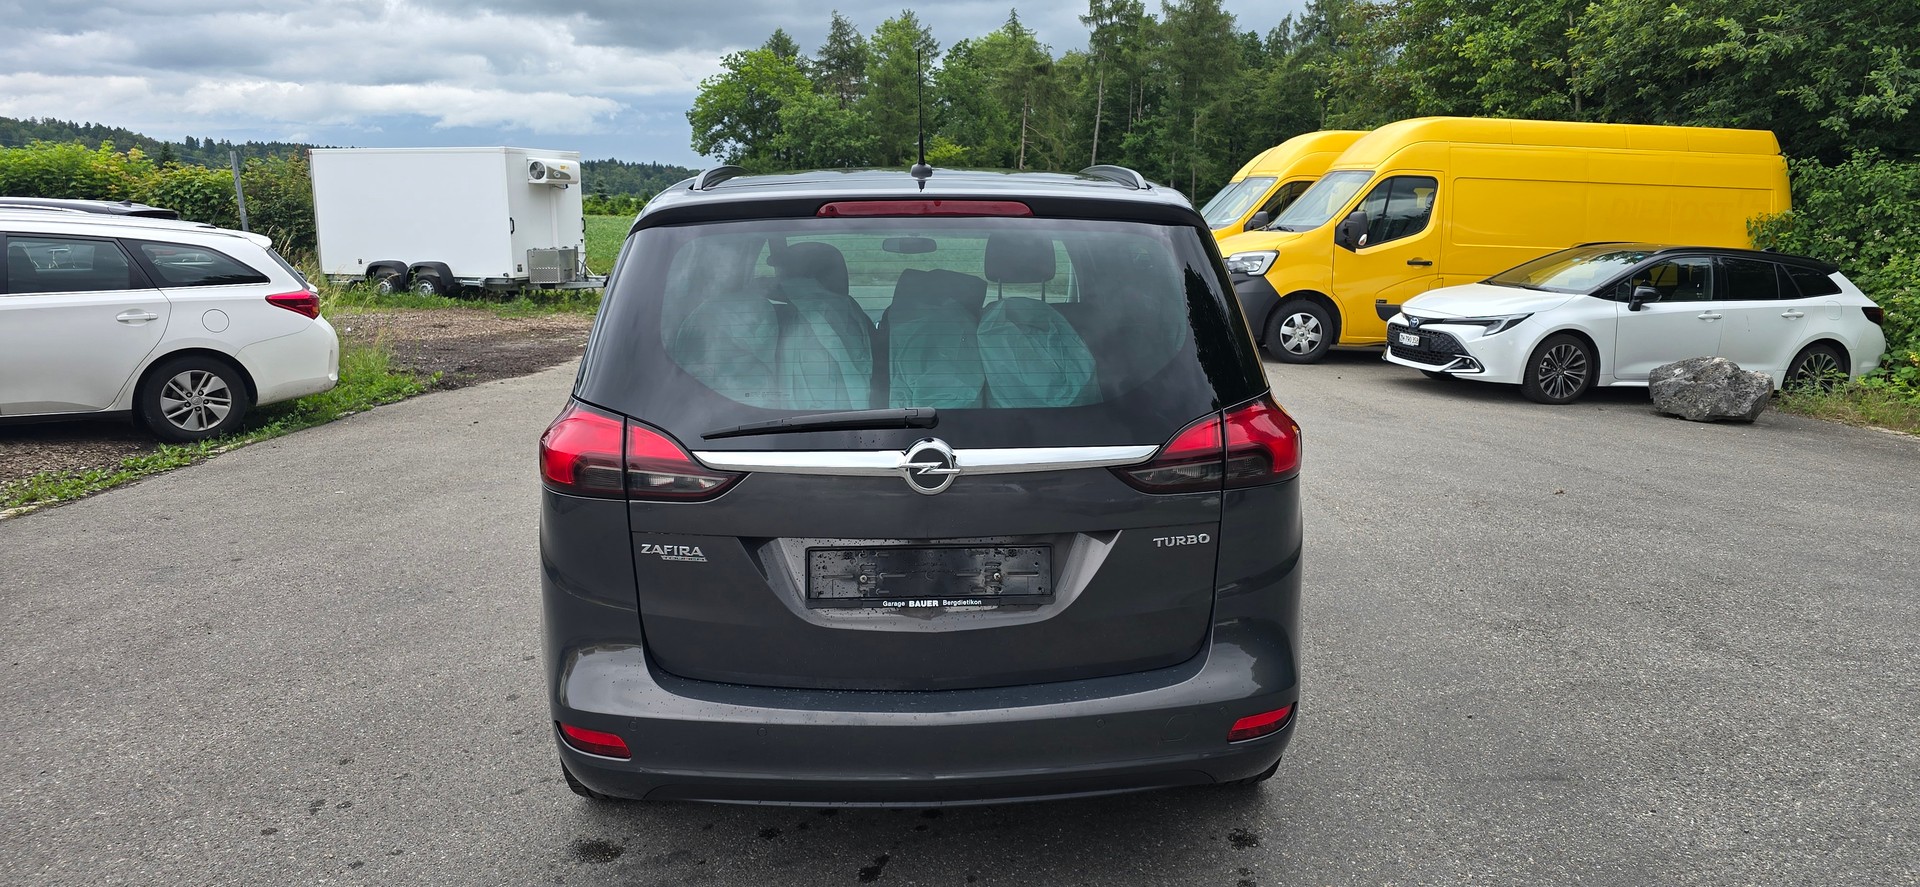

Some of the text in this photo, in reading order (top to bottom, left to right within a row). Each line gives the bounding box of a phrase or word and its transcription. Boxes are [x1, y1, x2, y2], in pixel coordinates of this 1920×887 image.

[1153, 533, 1210, 547] TURBO
[641, 543, 704, 557] ZAFIRA
[882, 600, 906, 608] Garage
[942, 599, 982, 607] Bergdietikon
